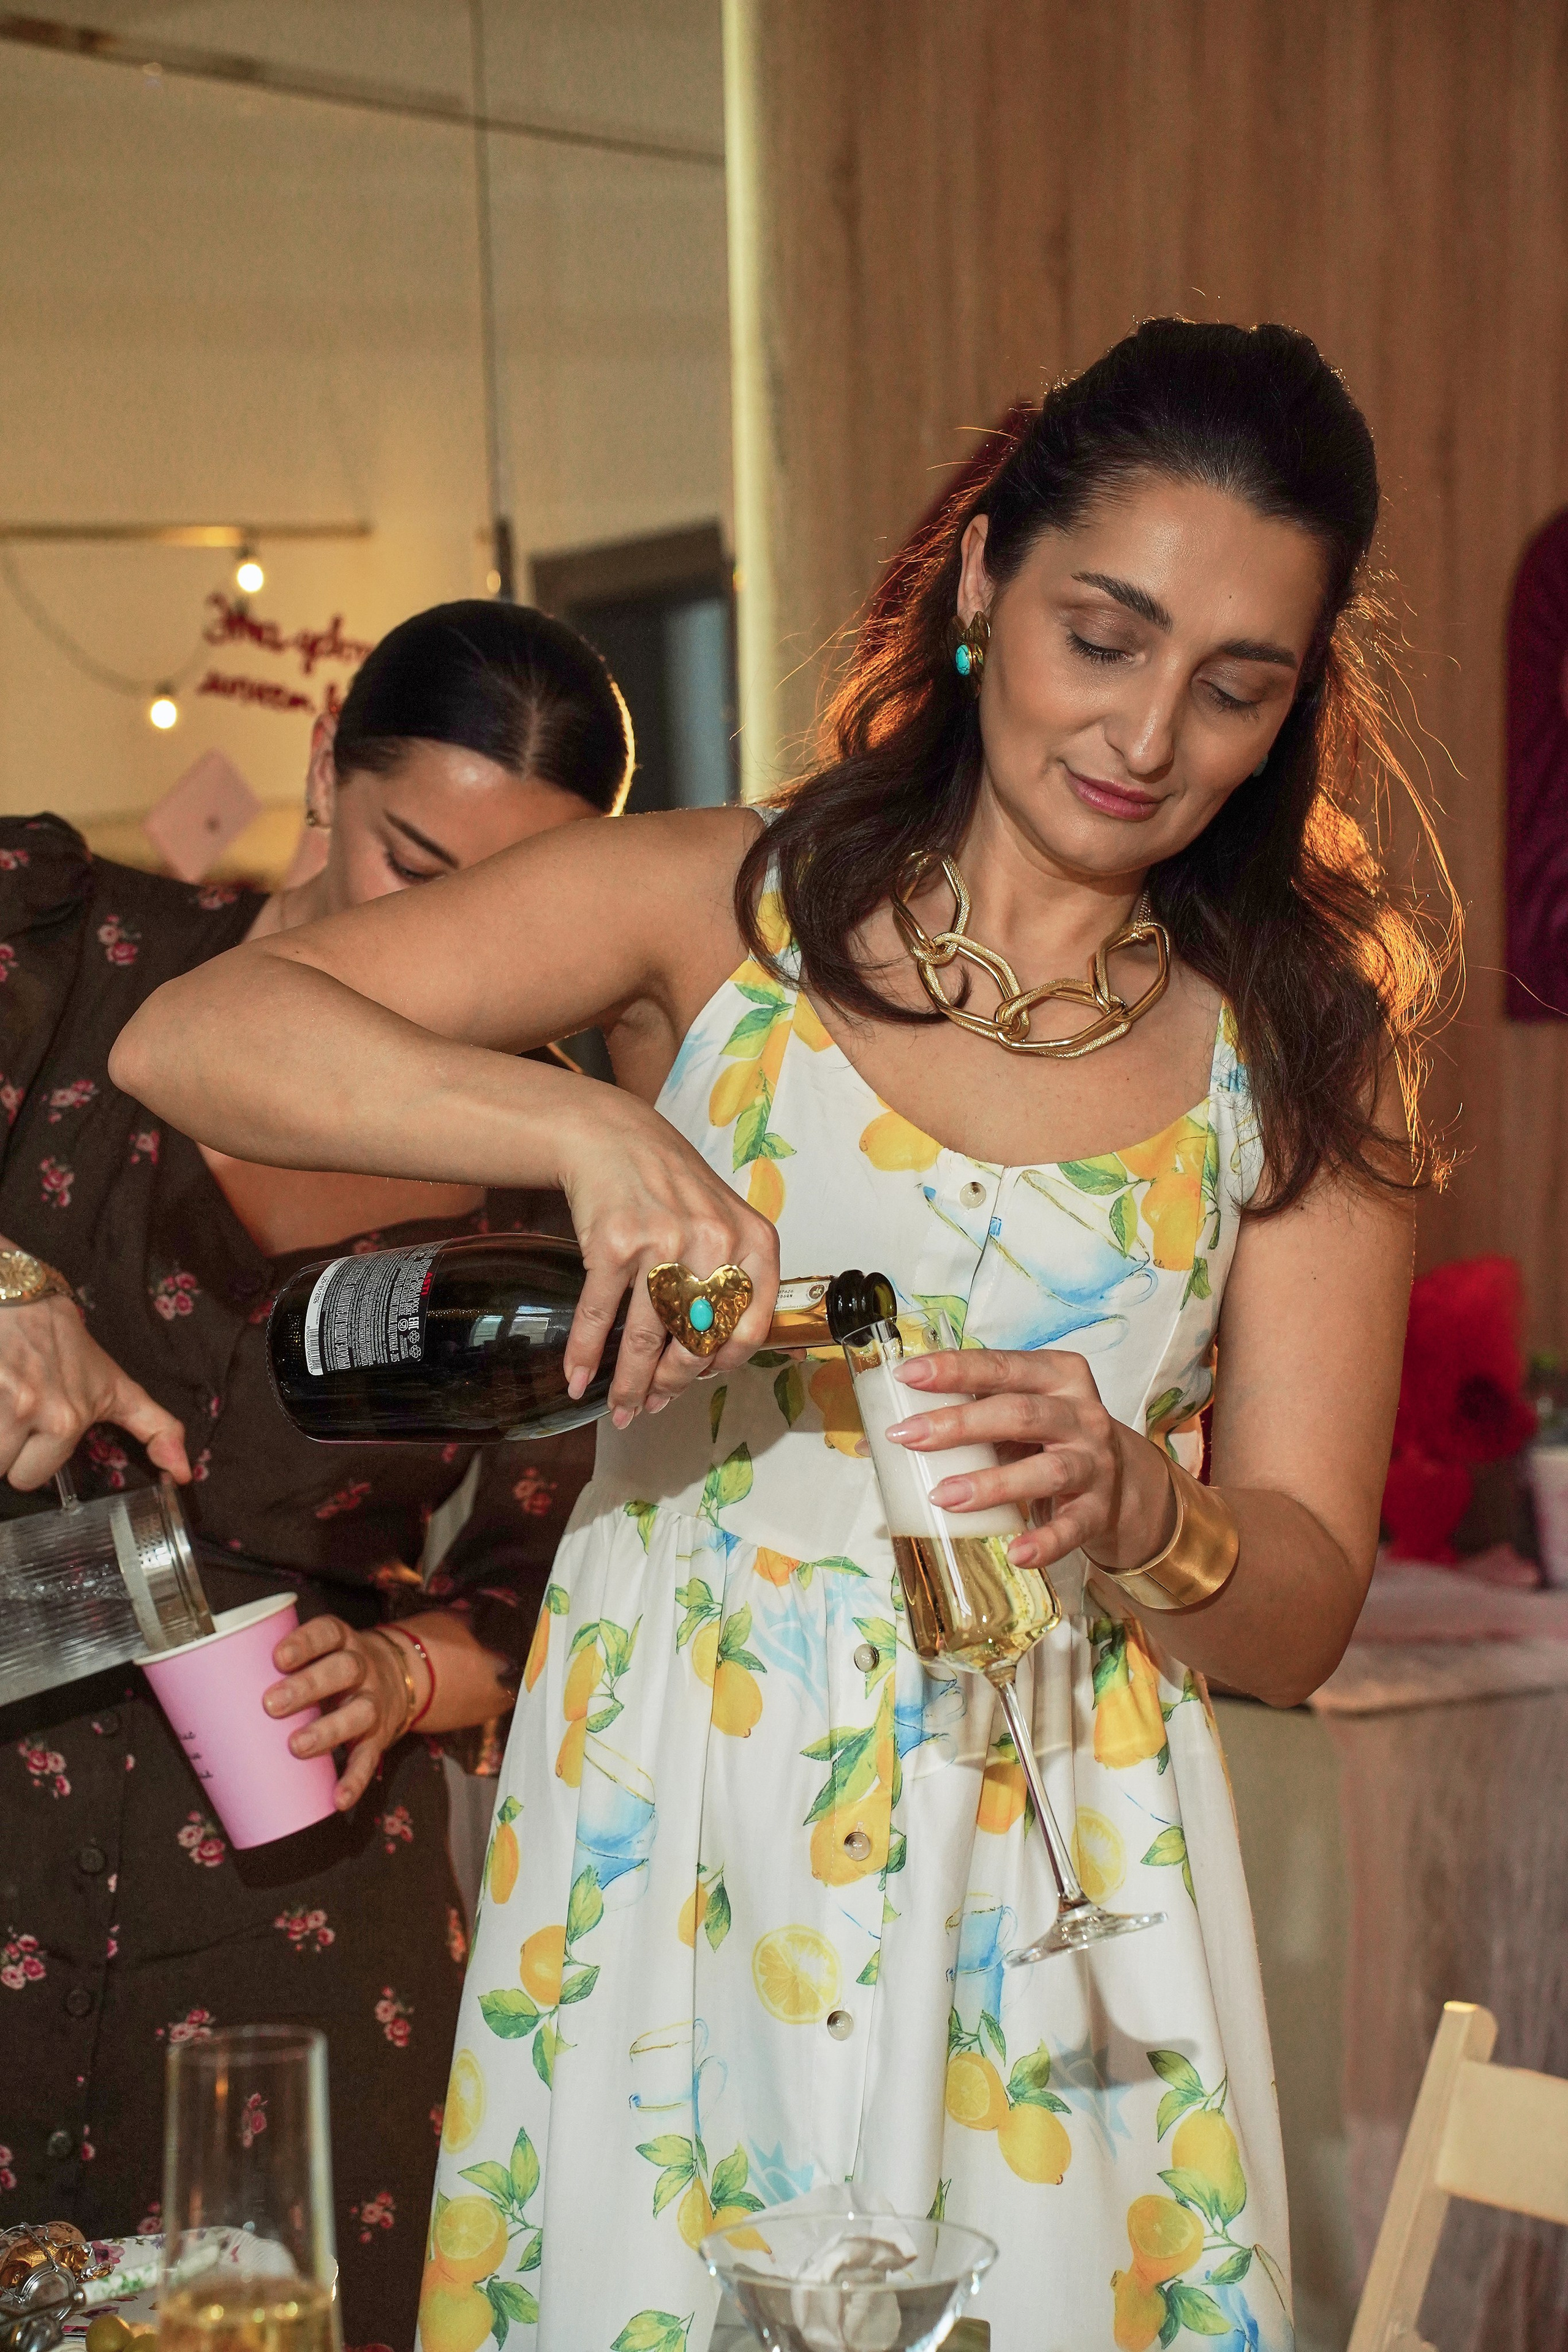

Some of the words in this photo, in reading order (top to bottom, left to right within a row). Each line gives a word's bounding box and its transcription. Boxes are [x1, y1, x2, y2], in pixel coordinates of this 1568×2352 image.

[420, 1272, 432, 1295] ASTI
[412, 1298, 420, 1313] DOCG
[335, 1343, 351, 1370] ЗДОРОВЬЮ
